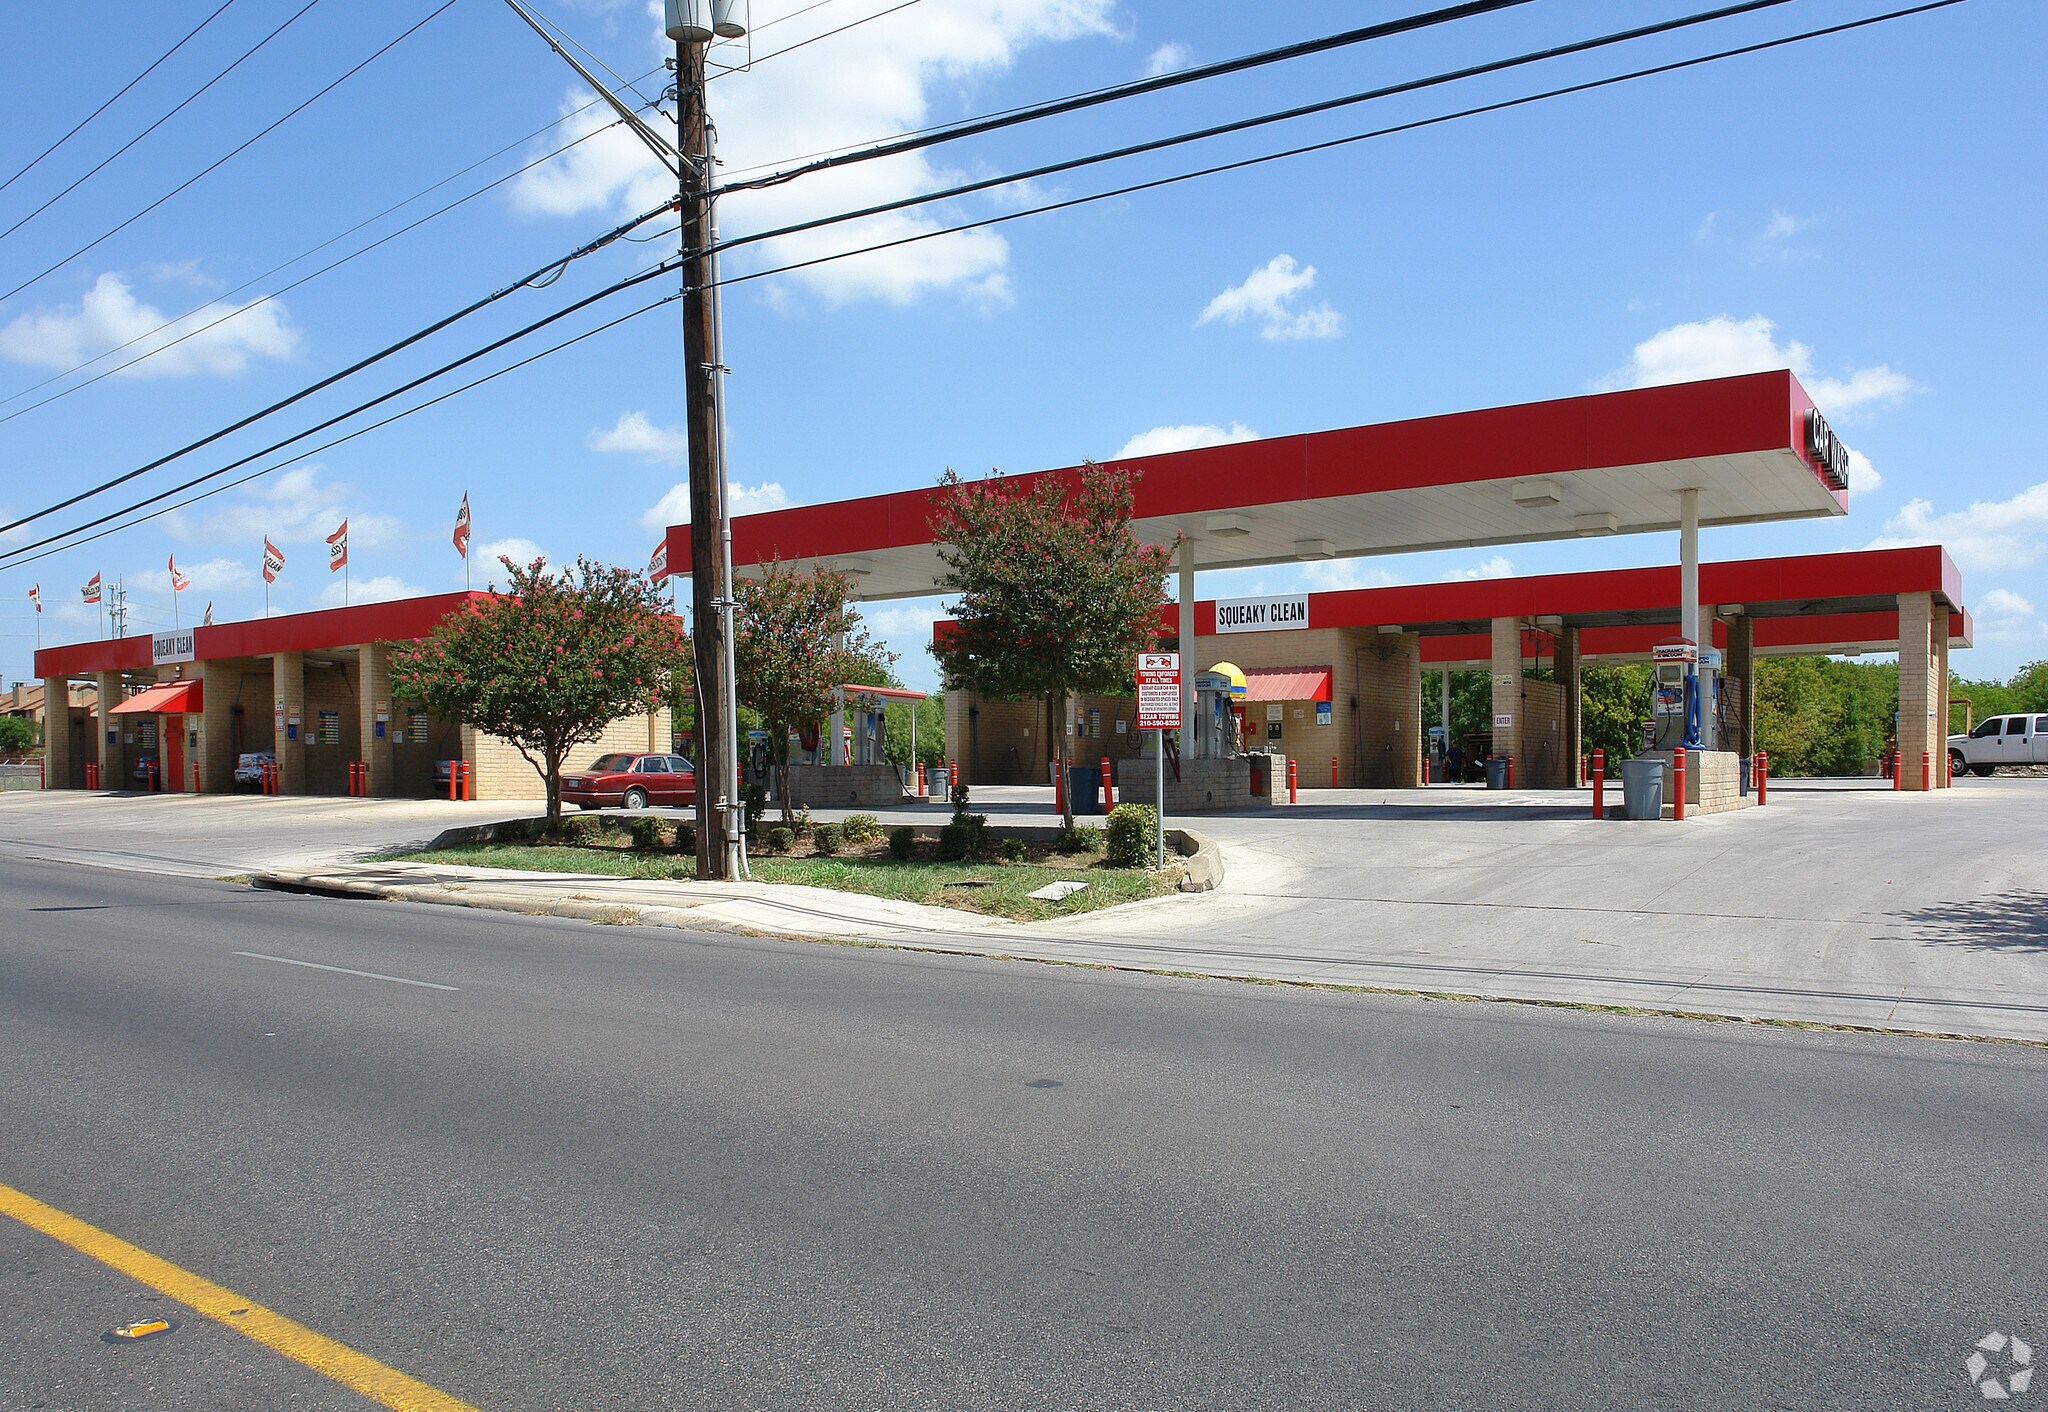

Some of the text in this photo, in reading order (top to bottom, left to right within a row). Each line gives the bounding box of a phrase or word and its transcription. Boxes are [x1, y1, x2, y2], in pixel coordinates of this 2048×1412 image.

[1811, 407, 1849, 489] CAR WASH
[1219, 602, 1305, 628] SQUEAKY CLEAN
[153, 635, 192, 660] SQUEAKY CLEAN
[1496, 717, 1511, 725] ENTER
